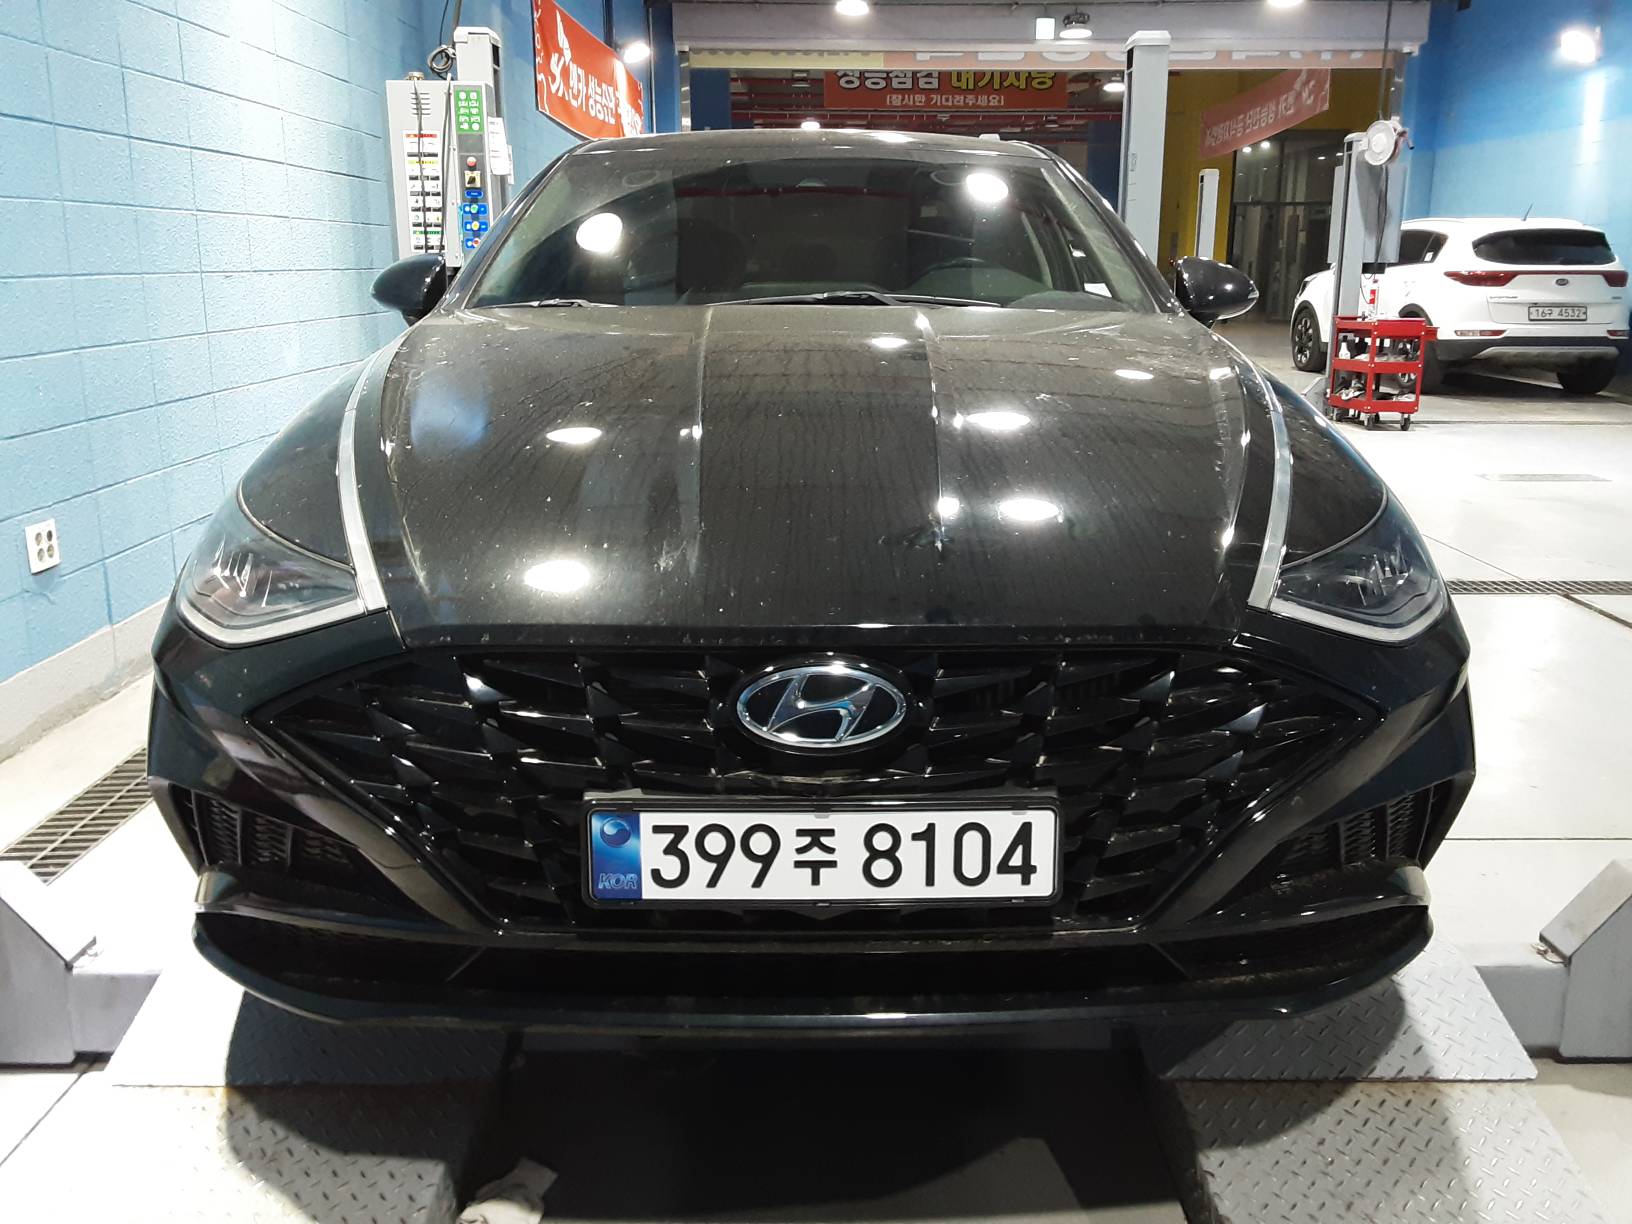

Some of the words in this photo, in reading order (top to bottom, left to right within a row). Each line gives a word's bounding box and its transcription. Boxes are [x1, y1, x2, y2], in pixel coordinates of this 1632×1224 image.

[1557, 308, 1583, 318] 4532
[650, 823, 838, 889] 399주
[862, 822, 1037, 888] 8104
[598, 872, 638, 889] KOR
